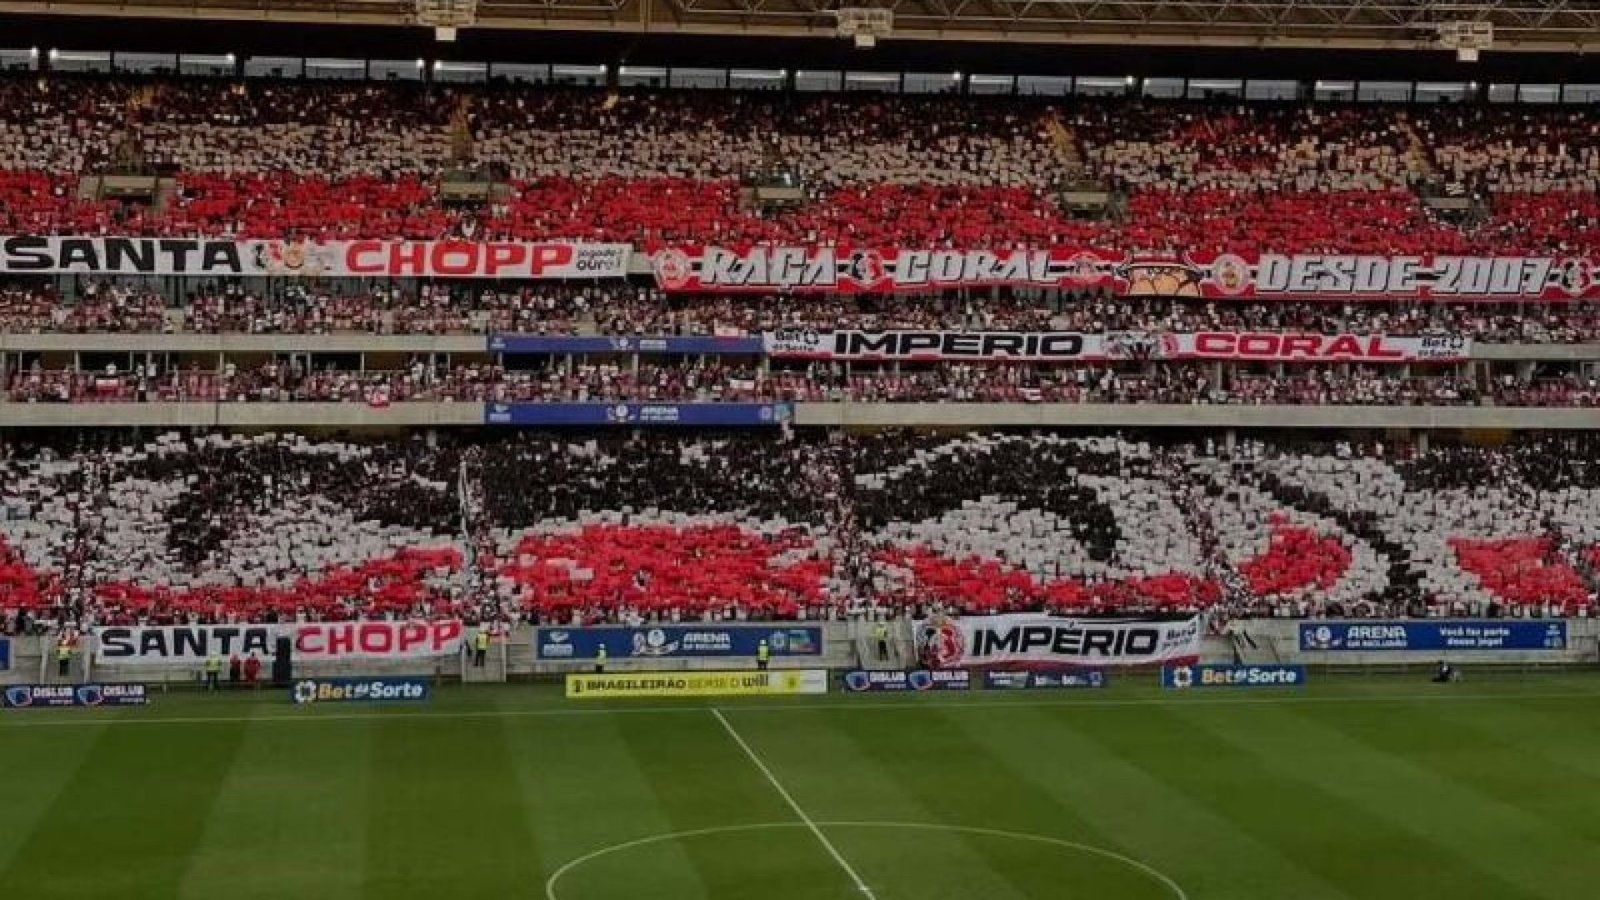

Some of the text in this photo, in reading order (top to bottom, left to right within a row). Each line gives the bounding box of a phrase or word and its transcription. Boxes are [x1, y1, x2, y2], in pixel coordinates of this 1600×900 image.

[4, 236, 573, 275] SANTA CHOPP
[897, 250, 1053, 285] CORAL
[1257, 255, 1419, 294] DESDE
[1430, 257, 1550, 294] 2007
[1195, 334, 1403, 358] CORAL
[101, 621, 461, 658] SANTA CHOPP
[1347, 626, 1407, 639] ARENA
[742, 673, 769, 687] will
[1201, 668, 1233, 684] Bet
[1248, 667, 1297, 683] Sorte
[33, 687, 73, 697] DISLUB
[103, 685, 145, 695] DISLUB
[318, 683, 353, 699] Bet
[370, 681, 423, 697] Sorte
